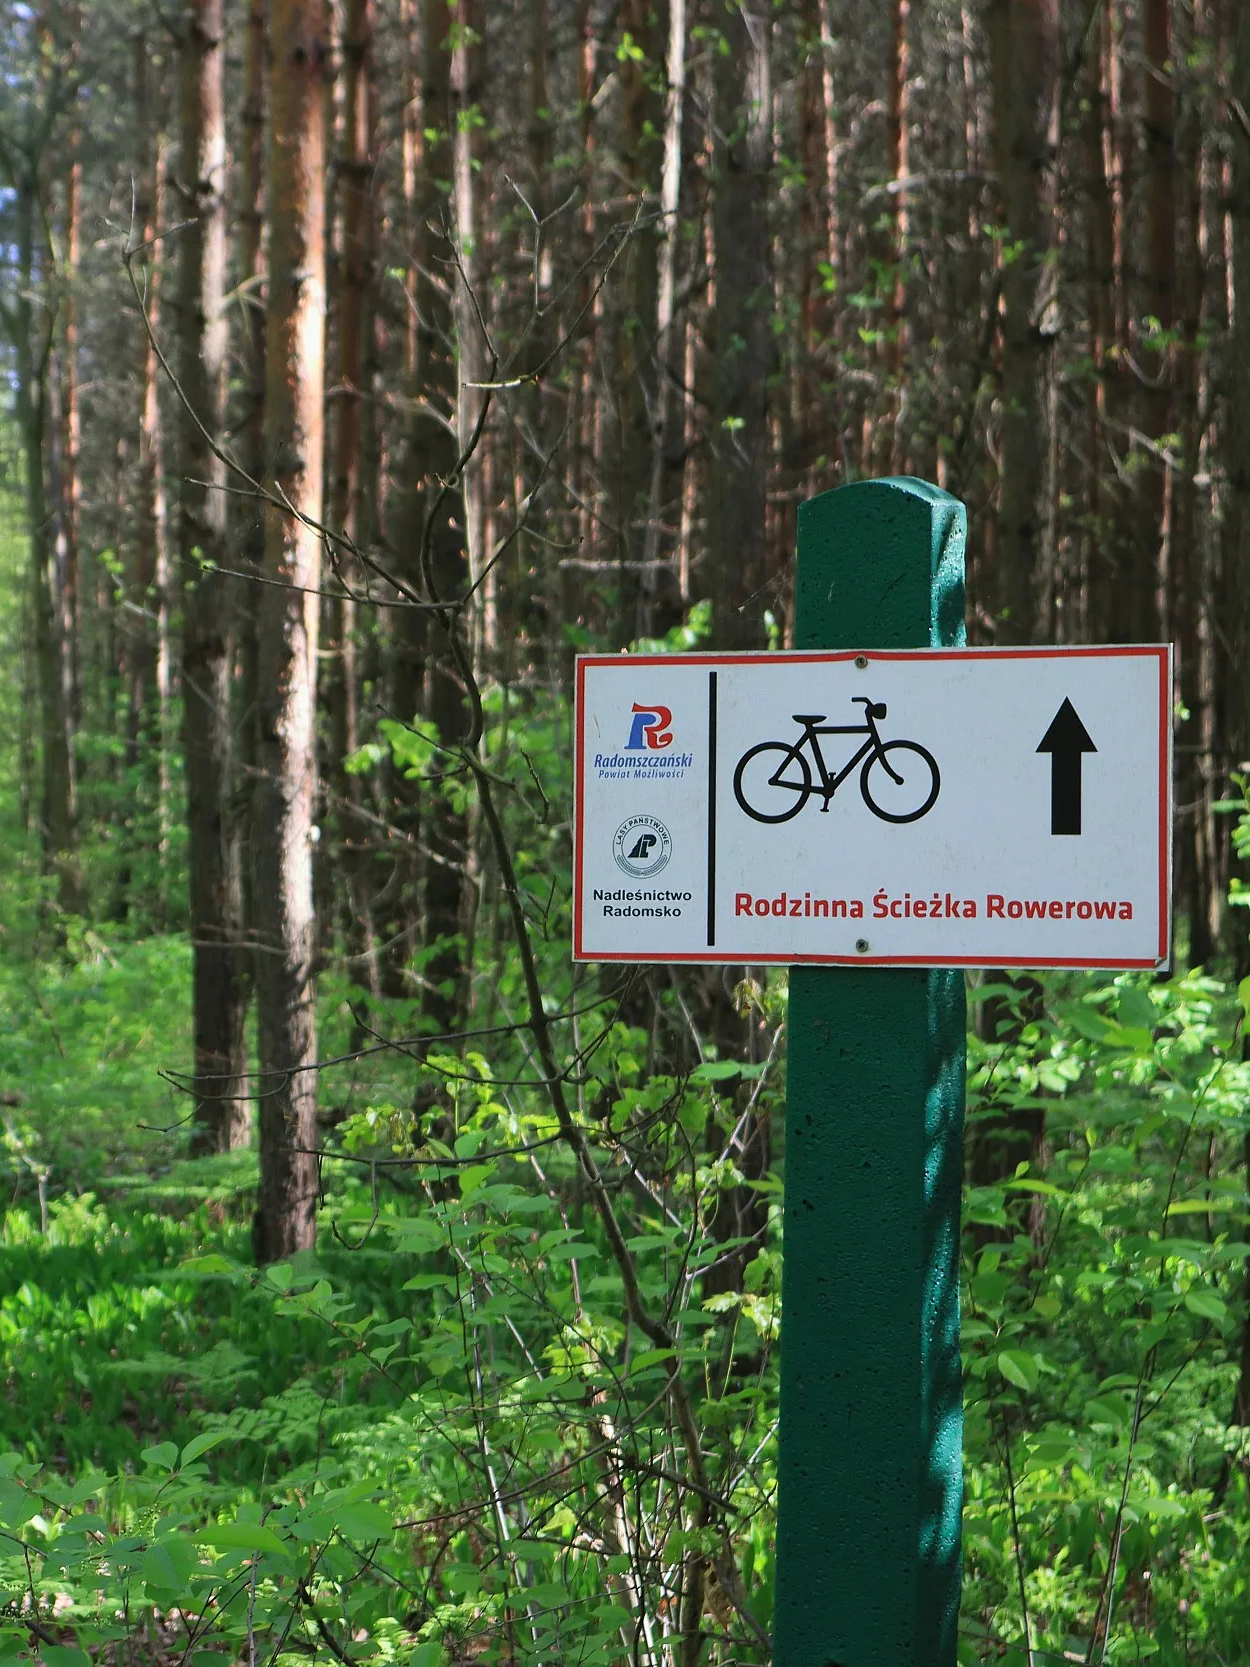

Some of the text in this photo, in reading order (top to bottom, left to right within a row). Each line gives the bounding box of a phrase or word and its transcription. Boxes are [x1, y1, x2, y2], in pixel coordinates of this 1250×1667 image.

[594, 753, 693, 768] Radomszczański
[599, 769, 684, 779] Powiat Możliwości
[615, 817, 670, 845] LASY PAŃSTWOWE
[593, 889, 692, 901] Nadleśnictwo
[735, 888, 1133, 920] Rodzinna Ścieżka Rowerowa
[603, 905, 681, 917] Radomsko
